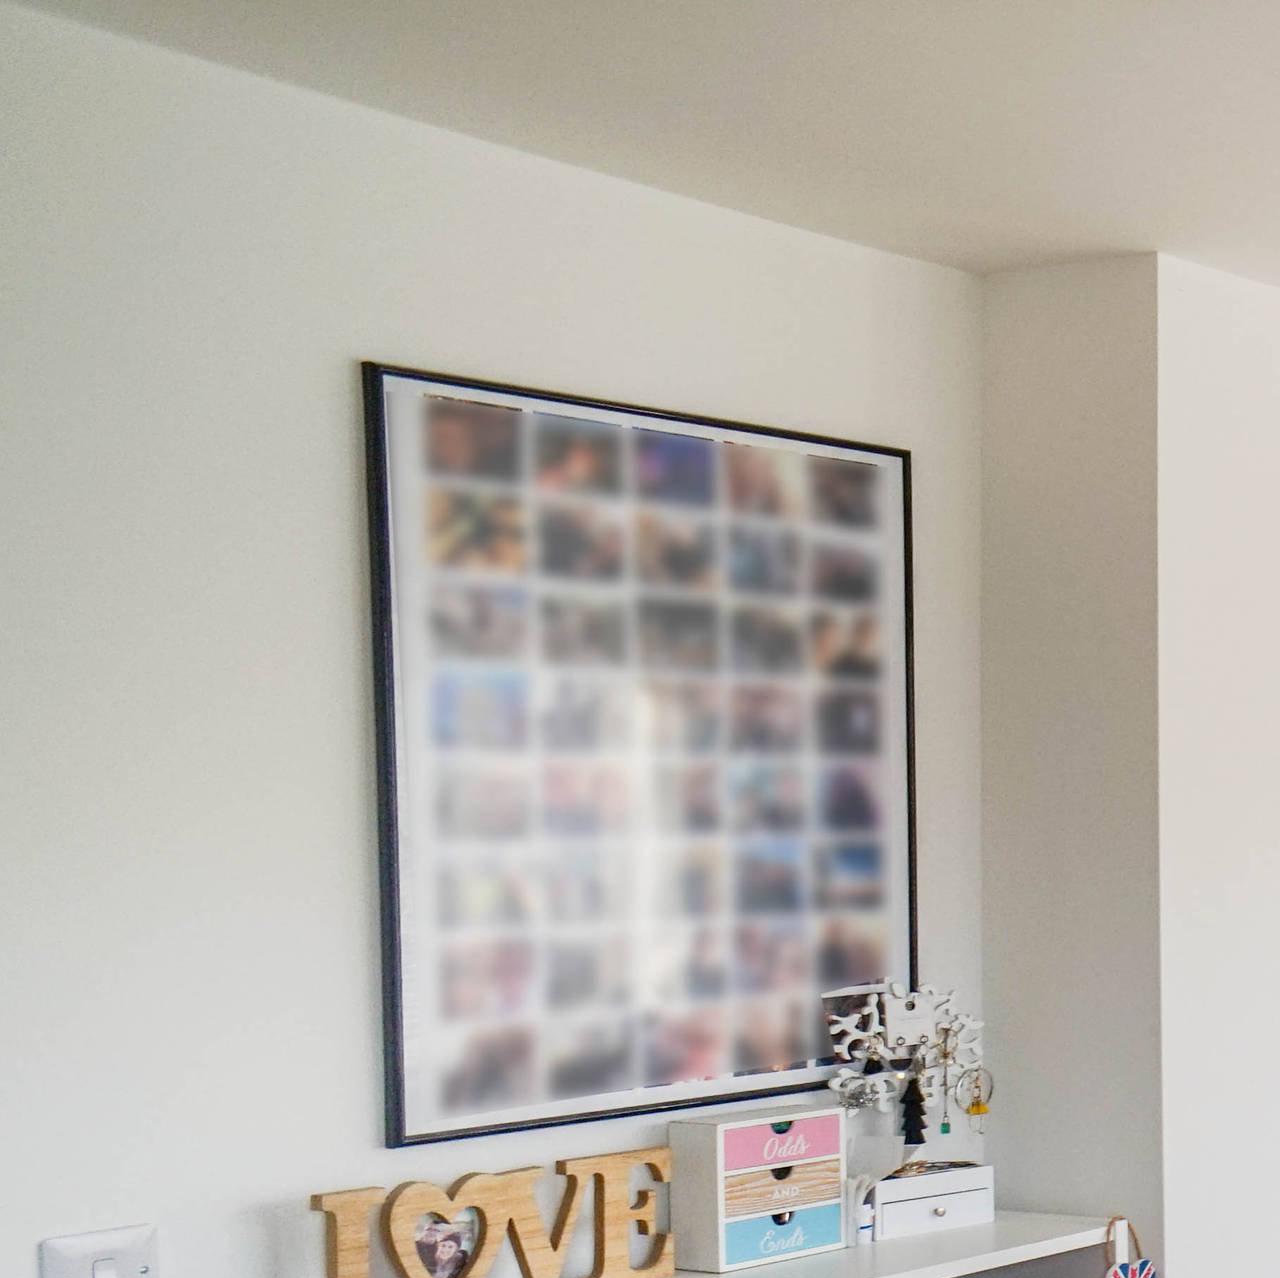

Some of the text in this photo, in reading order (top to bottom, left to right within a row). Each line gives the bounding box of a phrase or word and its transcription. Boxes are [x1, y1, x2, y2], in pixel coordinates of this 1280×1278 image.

[763, 1134, 810, 1160] Odds
[771, 1186, 800, 1199] AND
[760, 1226, 807, 1254] Ends
